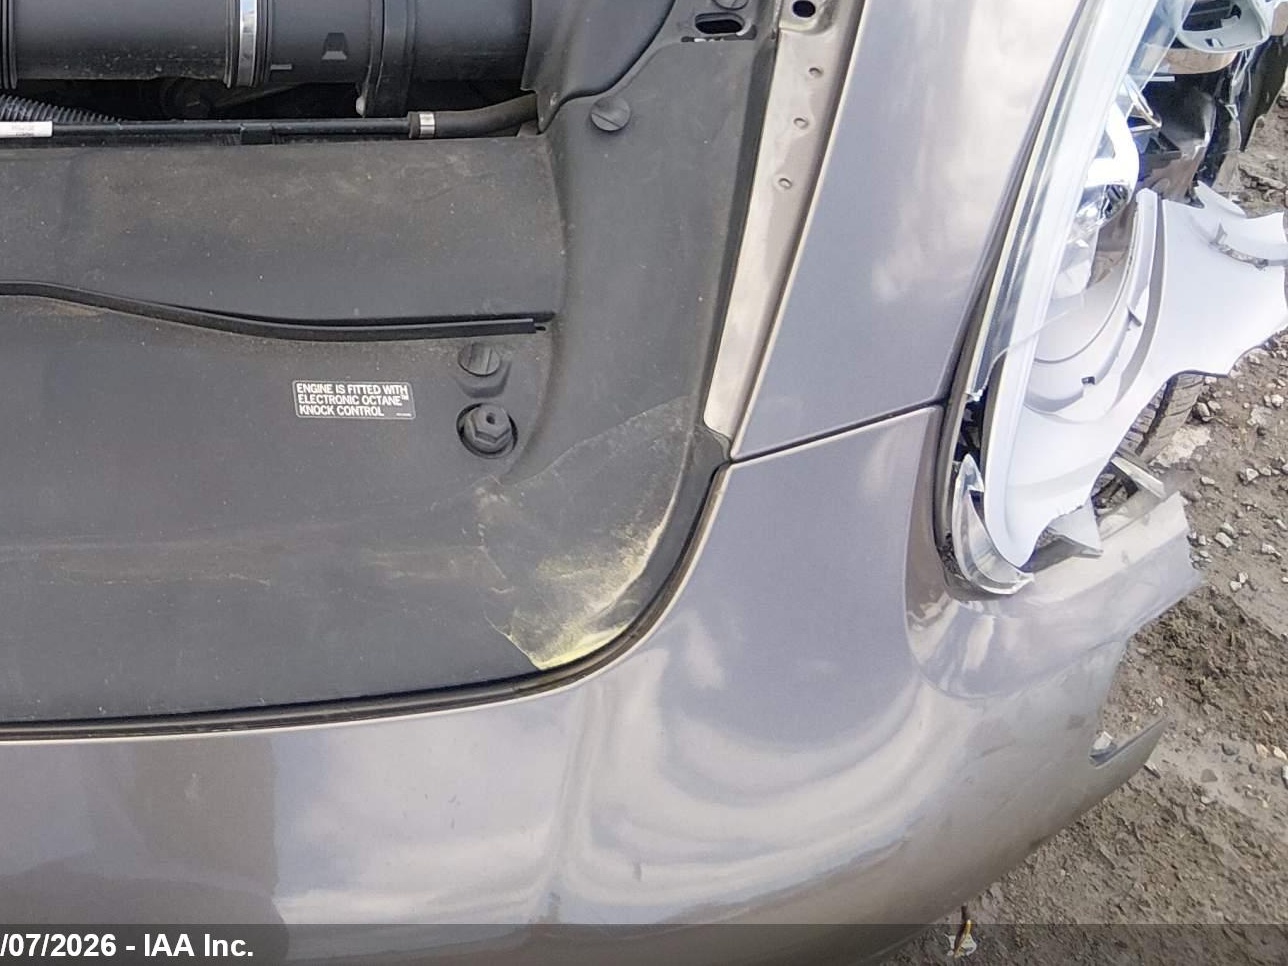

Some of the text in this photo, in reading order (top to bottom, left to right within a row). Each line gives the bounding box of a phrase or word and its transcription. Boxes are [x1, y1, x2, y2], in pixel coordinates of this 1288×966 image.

[296, 383, 408, 395] ENGINE IS FITTED WITH
[297, 394, 360, 404] ELECTRONIC
[299, 405, 385, 416] KNOCK CONTROL
